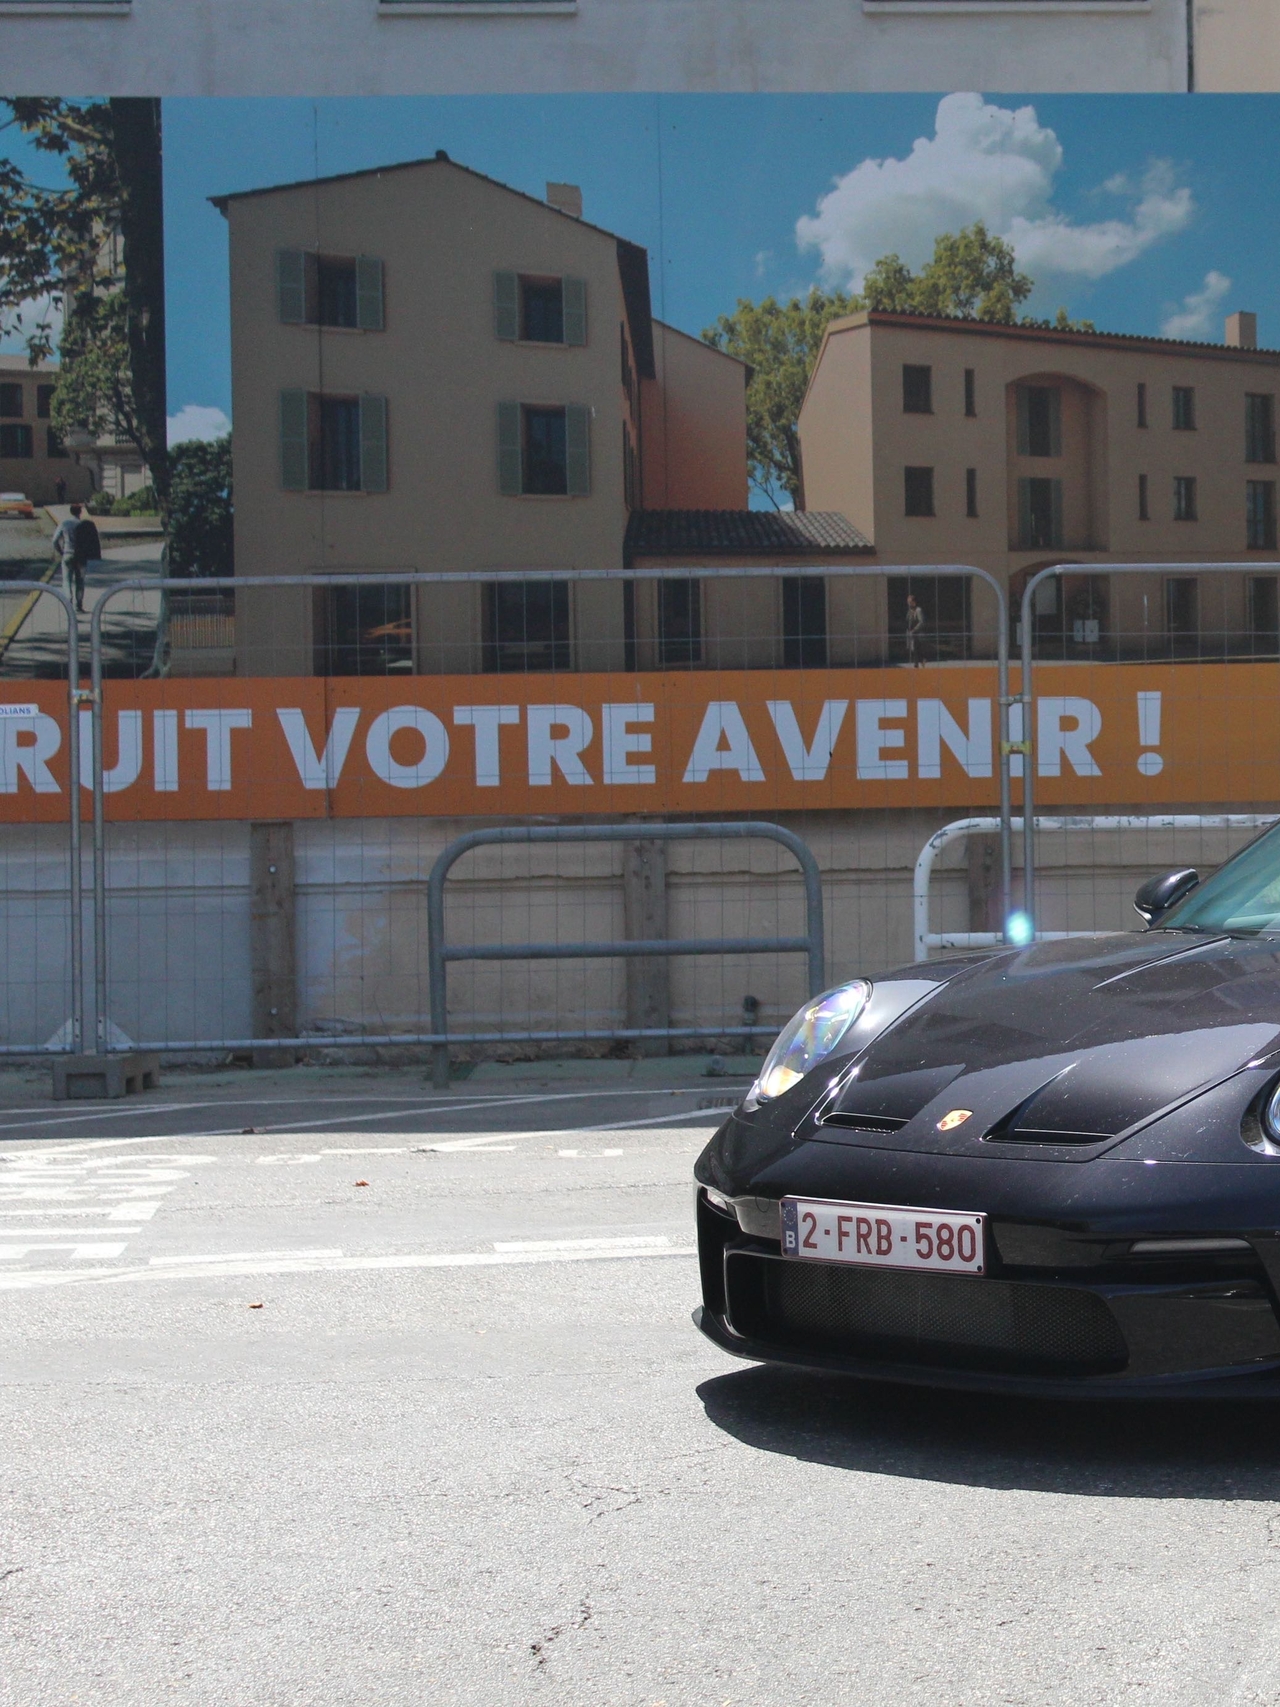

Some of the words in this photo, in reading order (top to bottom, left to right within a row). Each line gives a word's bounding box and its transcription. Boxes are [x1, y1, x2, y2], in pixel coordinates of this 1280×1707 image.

[0, 706, 251, 793] RUIT
[276, 703, 656, 790] VOTRE
[682, 697, 1102, 782] AVENIR
[1137, 691, 1163, 776] !
[785, 1231, 796, 1248] B
[802, 1212, 976, 1262] 2-FRB-580
